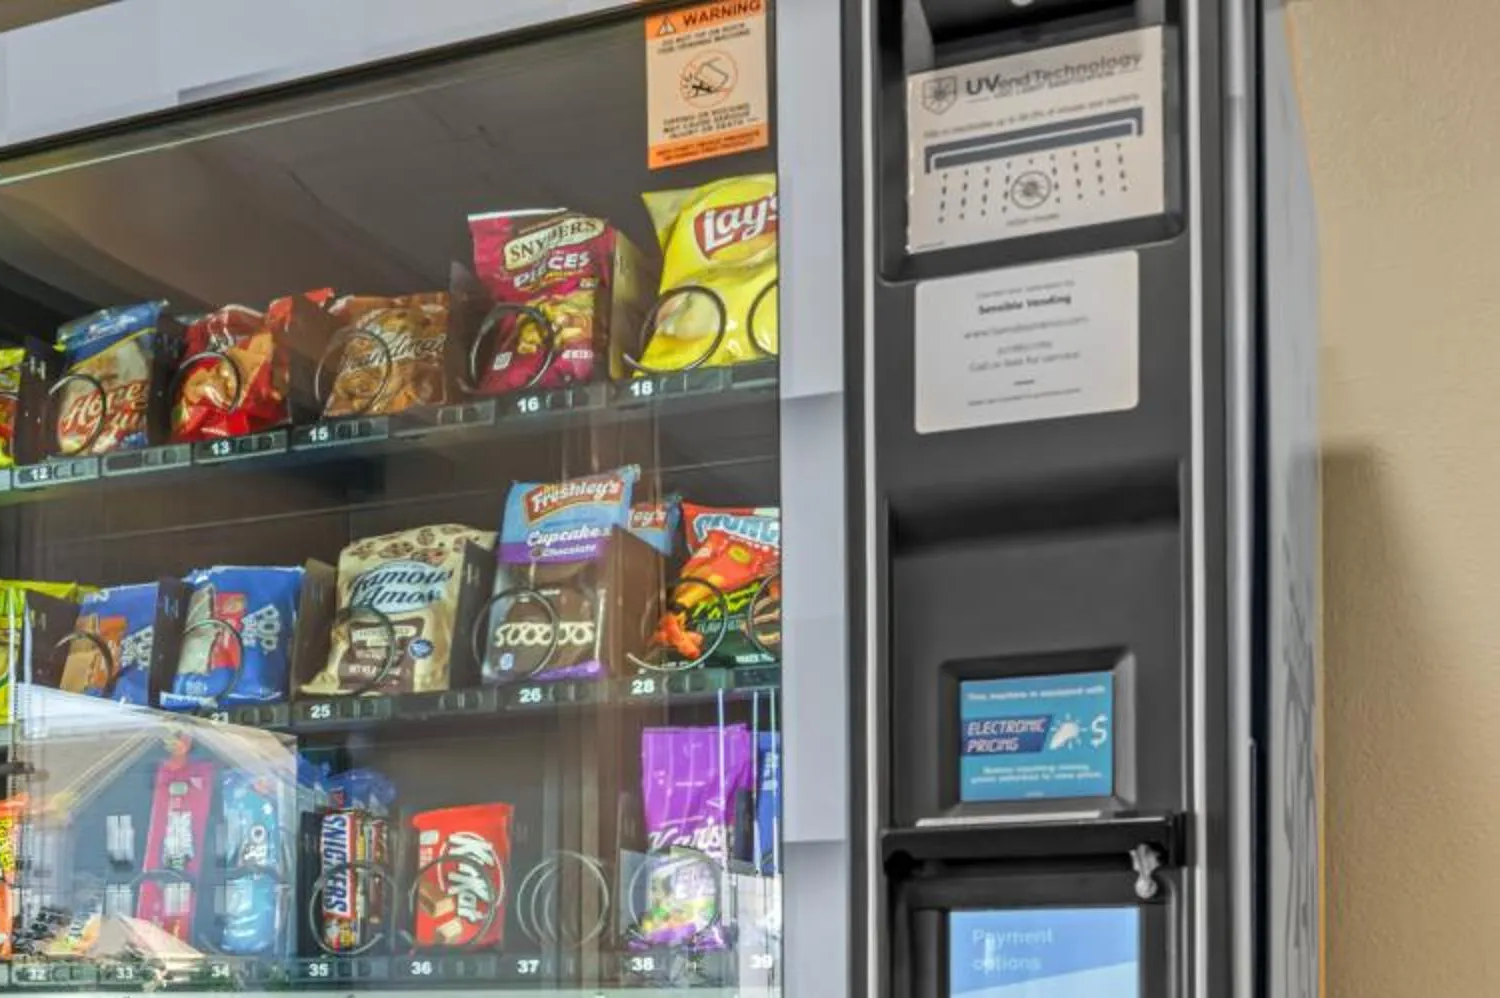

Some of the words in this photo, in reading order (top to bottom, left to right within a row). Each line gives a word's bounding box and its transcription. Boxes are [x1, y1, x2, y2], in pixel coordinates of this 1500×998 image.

[683, 0, 761, 26] WARNING
[516, 397, 539, 413] 16
[308, 426, 329, 442] 15
[211, 440, 230, 455] 13
[31, 467, 49, 481] 12
[631, 679, 654, 695] 28
[519, 688, 541, 703] 26
[310, 704, 331, 719] 25
[966, 718, 1047, 736] ELECTRONIC
[966, 737, 1019, 753] PRICING
[972, 927, 1054, 947] Payment
[308, 963, 329, 977] 35
[410, 961, 432, 976] 36
[516, 959, 540, 974] 37
[631, 956, 654, 972] 38
[971, 955, 1043, 976] options
